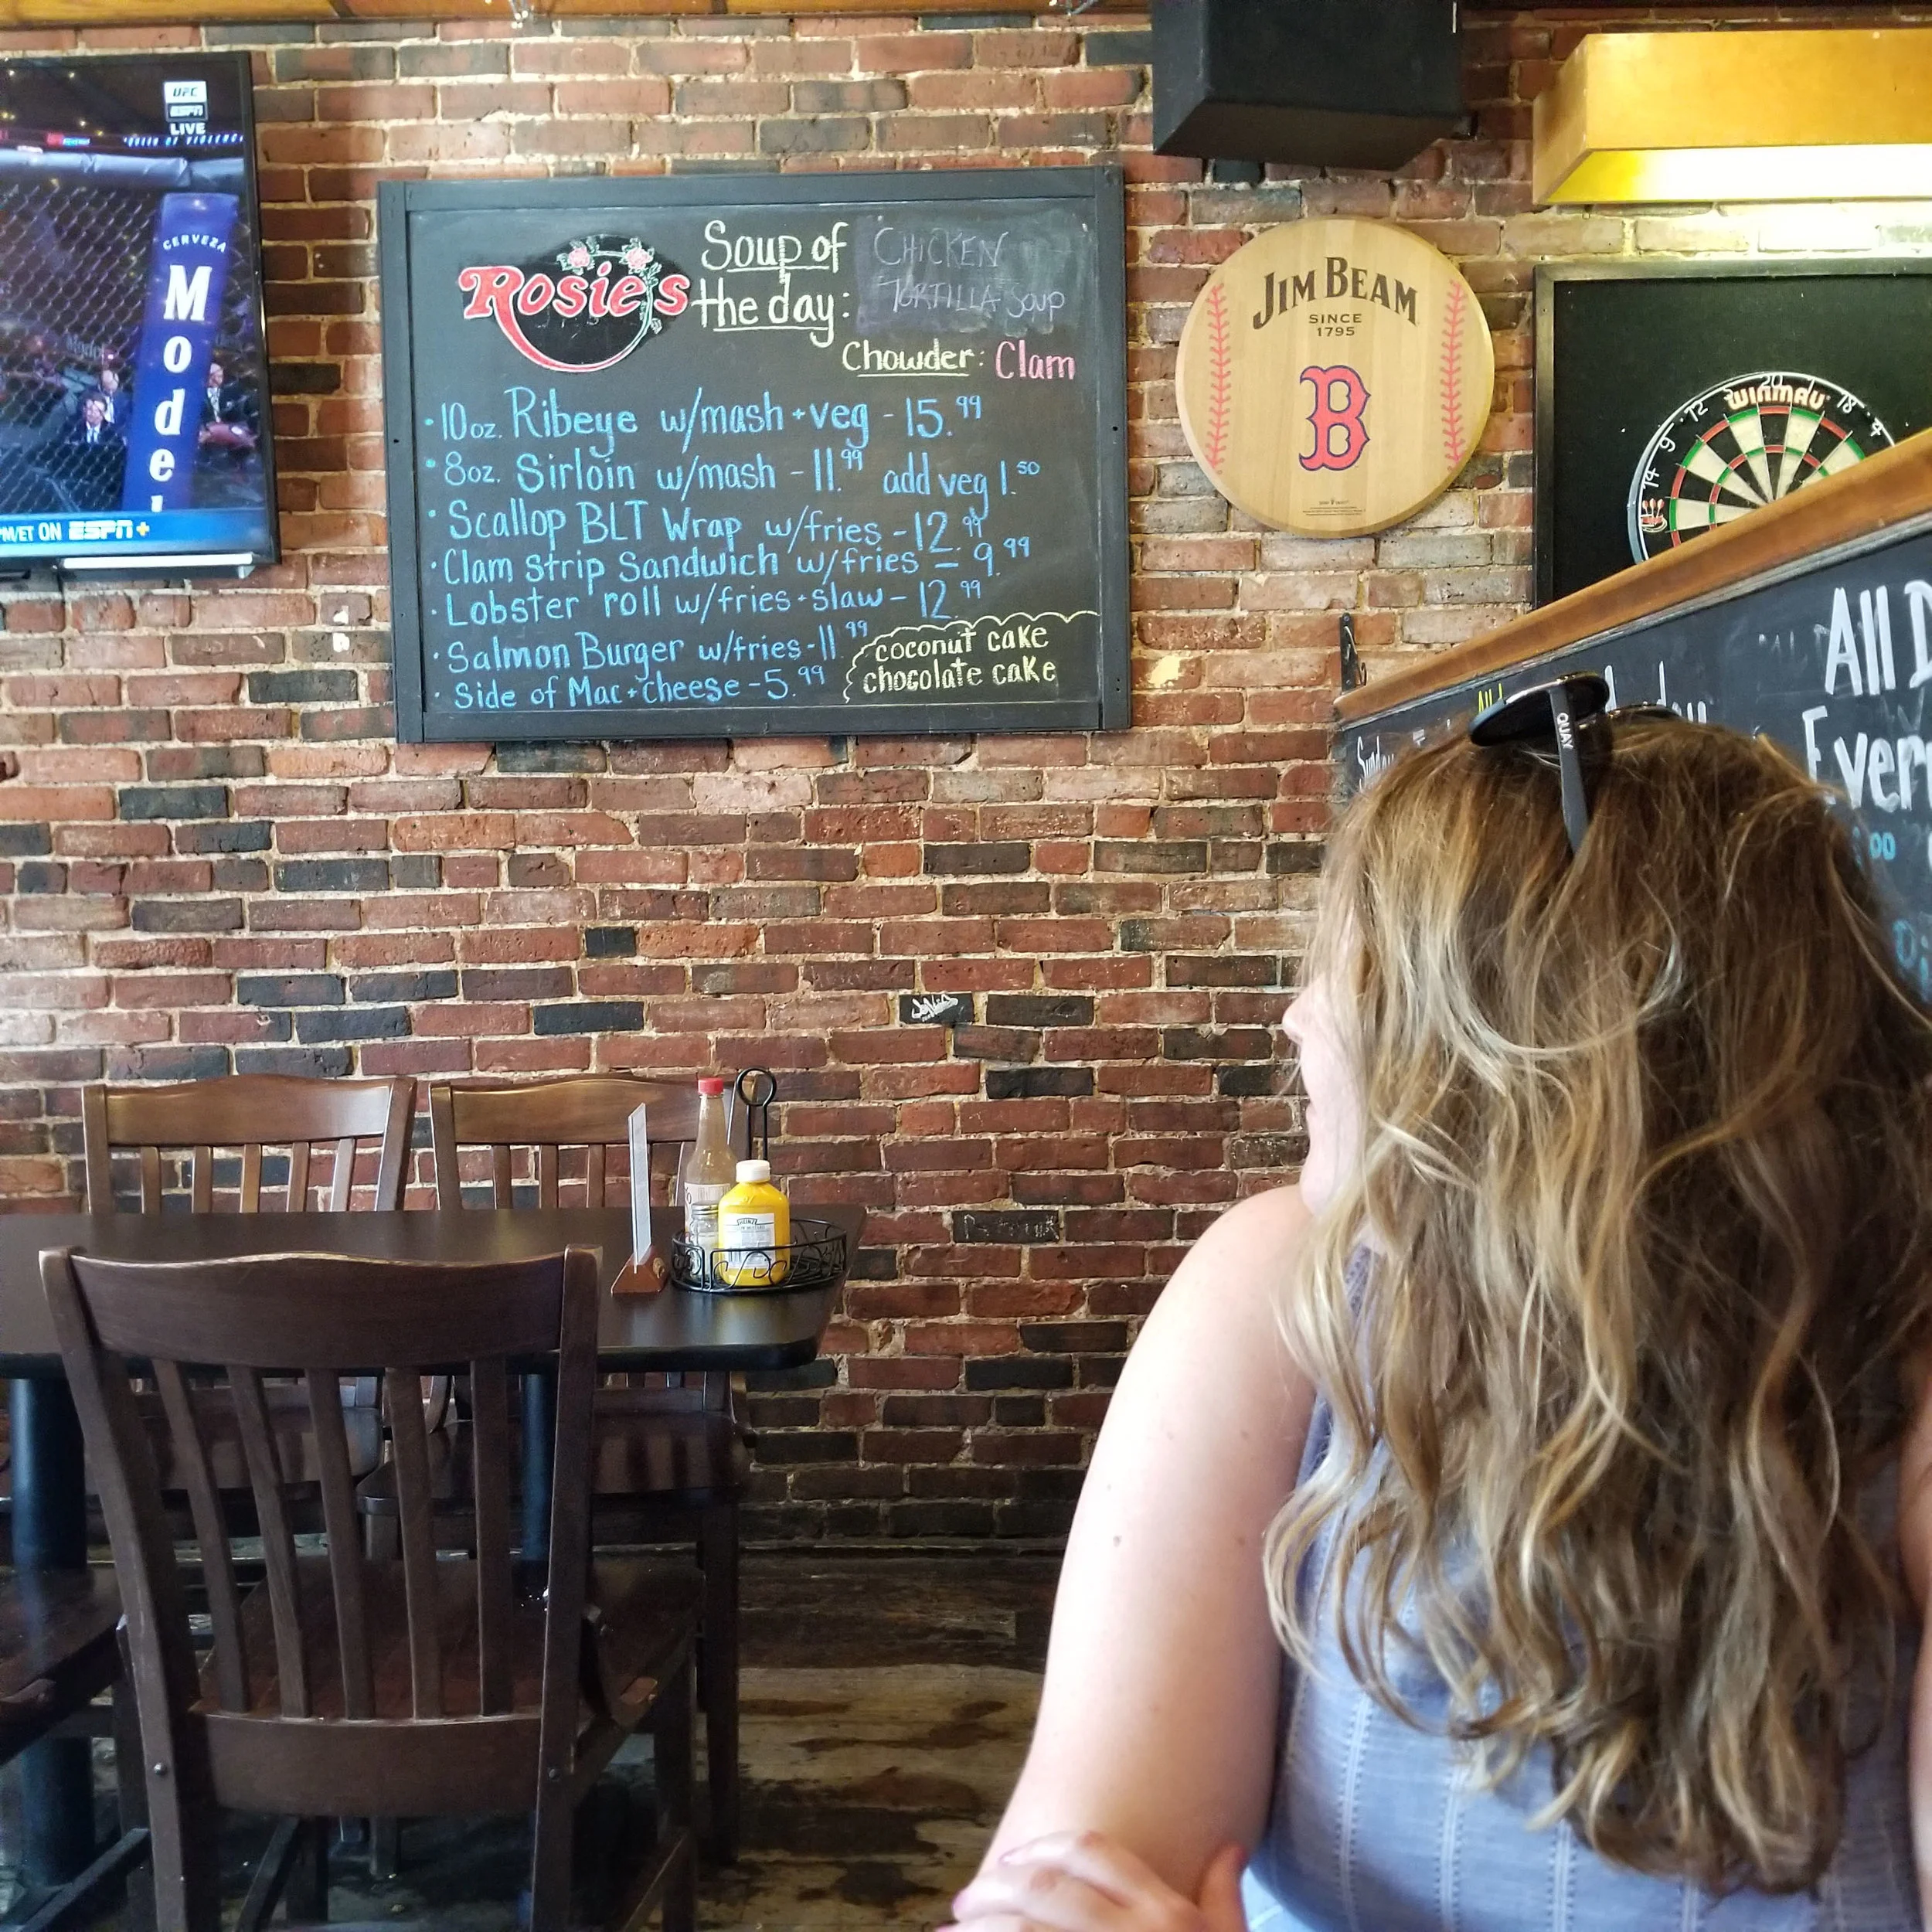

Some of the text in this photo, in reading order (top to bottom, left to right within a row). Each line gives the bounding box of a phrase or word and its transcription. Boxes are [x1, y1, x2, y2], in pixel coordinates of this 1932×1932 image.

[169, 122, 206, 136] LIVE
[162, 233, 227, 253] CERVEZA
[702, 219, 849, 284] Soup of
[692, 277, 758, 328] the
[1252, 256, 1420, 331] JIM BEAM
[1308, 313, 1362, 325] SINCE
[1316, 326, 1356, 337] 1795
[842, 338, 1076, 380] Chowder: Clam
[503, 386, 639, 457] Ribeye
[1298, 364, 1372, 472] B
[515, 447, 635, 494] Sirloin
[883, 451, 931, 495] add
[937, 473, 989, 520] veg
[0, 526, 34, 543] M/ET
[38, 522, 63, 542] ON
[448, 497, 566, 551] Scallop
[575, 499, 649, 544] BLT
[662, 506, 743, 552] Wrap
[765, 505, 882, 554] w/fries
[444, 548, 514, 584] Clam
[619, 543, 779, 582] Sandwich
[797, 549, 920, 586] w/fries
[446, 587, 580, 626] Lobster
[604, 583, 661, 618] roll
[447, 636, 570, 674] Salmon
[574, 631, 685, 682] Burger
[875, 627, 977, 662] coconut
[1824, 584, 1896, 696] All
[454, 675, 517, 709] Side
[530, 675, 559, 709] of
[862, 657, 983, 694] chocolate
[1556, 712, 1574, 750] QUAY
[1801, 704, 1932, 813] Ever
